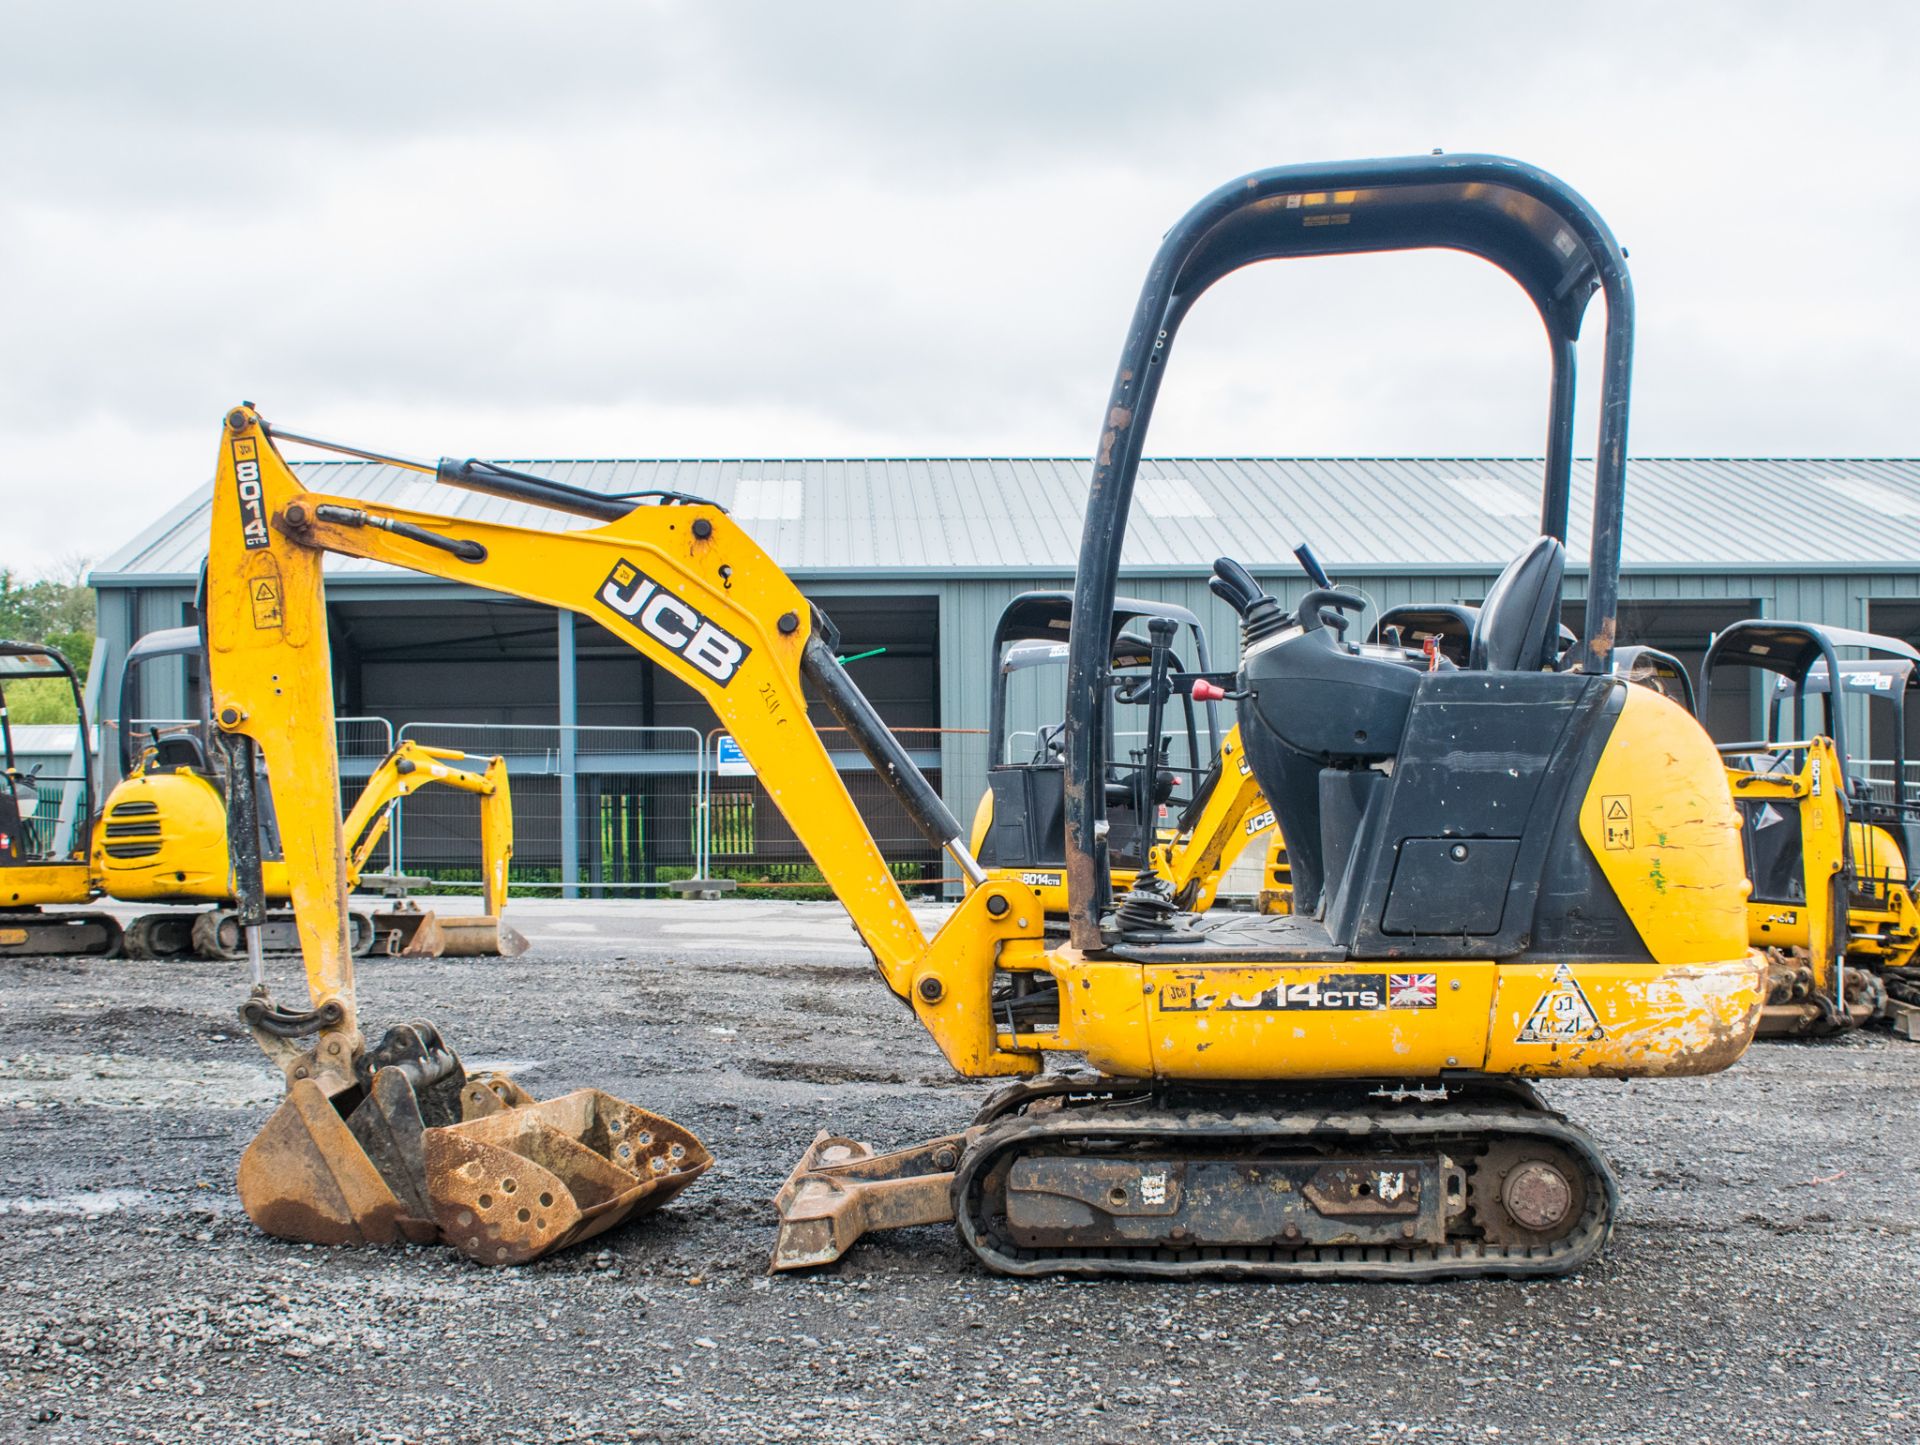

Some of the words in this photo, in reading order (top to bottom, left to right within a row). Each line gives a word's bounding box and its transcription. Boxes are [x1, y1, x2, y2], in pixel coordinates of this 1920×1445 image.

[236, 461, 266, 536] 8014
[603, 578, 743, 680] JCB
[1246, 810, 1276, 834] JCB
